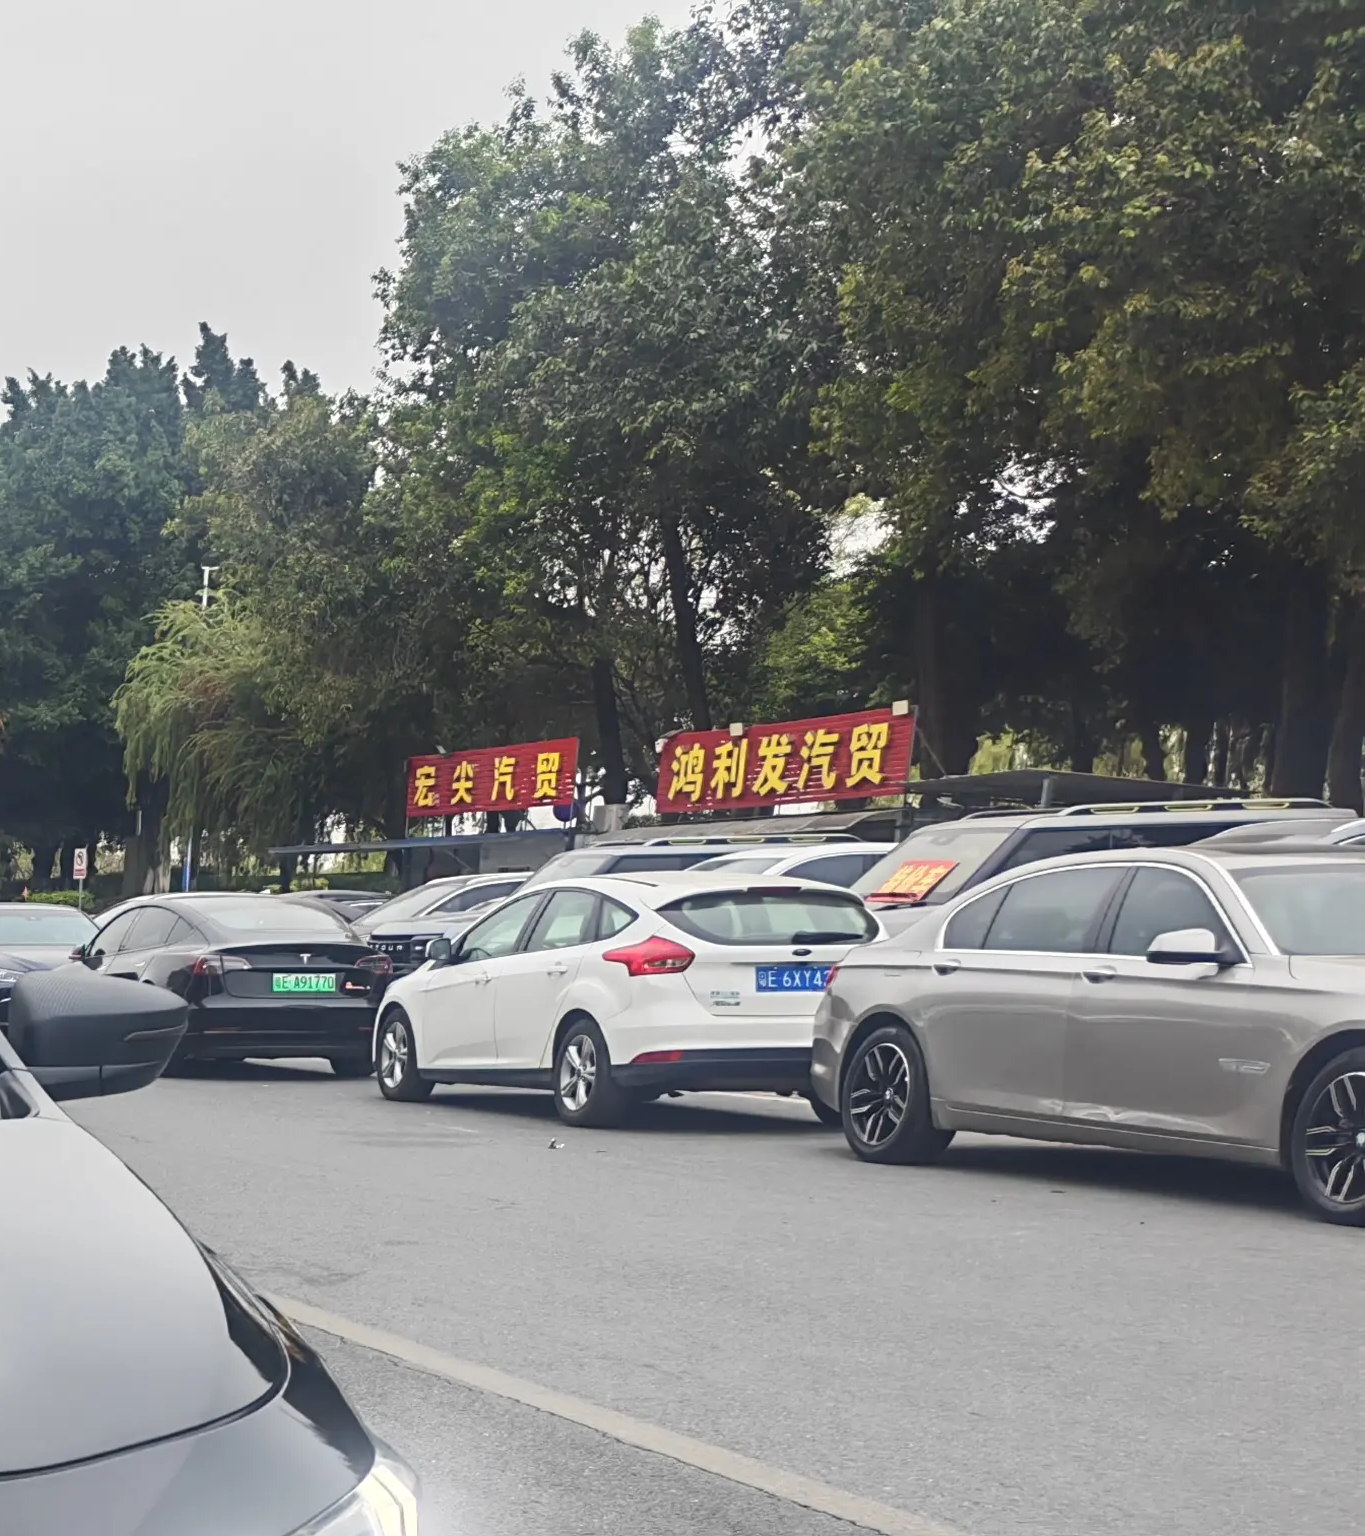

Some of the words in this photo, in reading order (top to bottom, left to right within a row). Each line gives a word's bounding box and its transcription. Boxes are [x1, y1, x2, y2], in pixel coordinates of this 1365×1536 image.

[413, 752, 561, 807] 宏尖汽贸
[667, 722, 890, 802] 鸿利发汽贸
